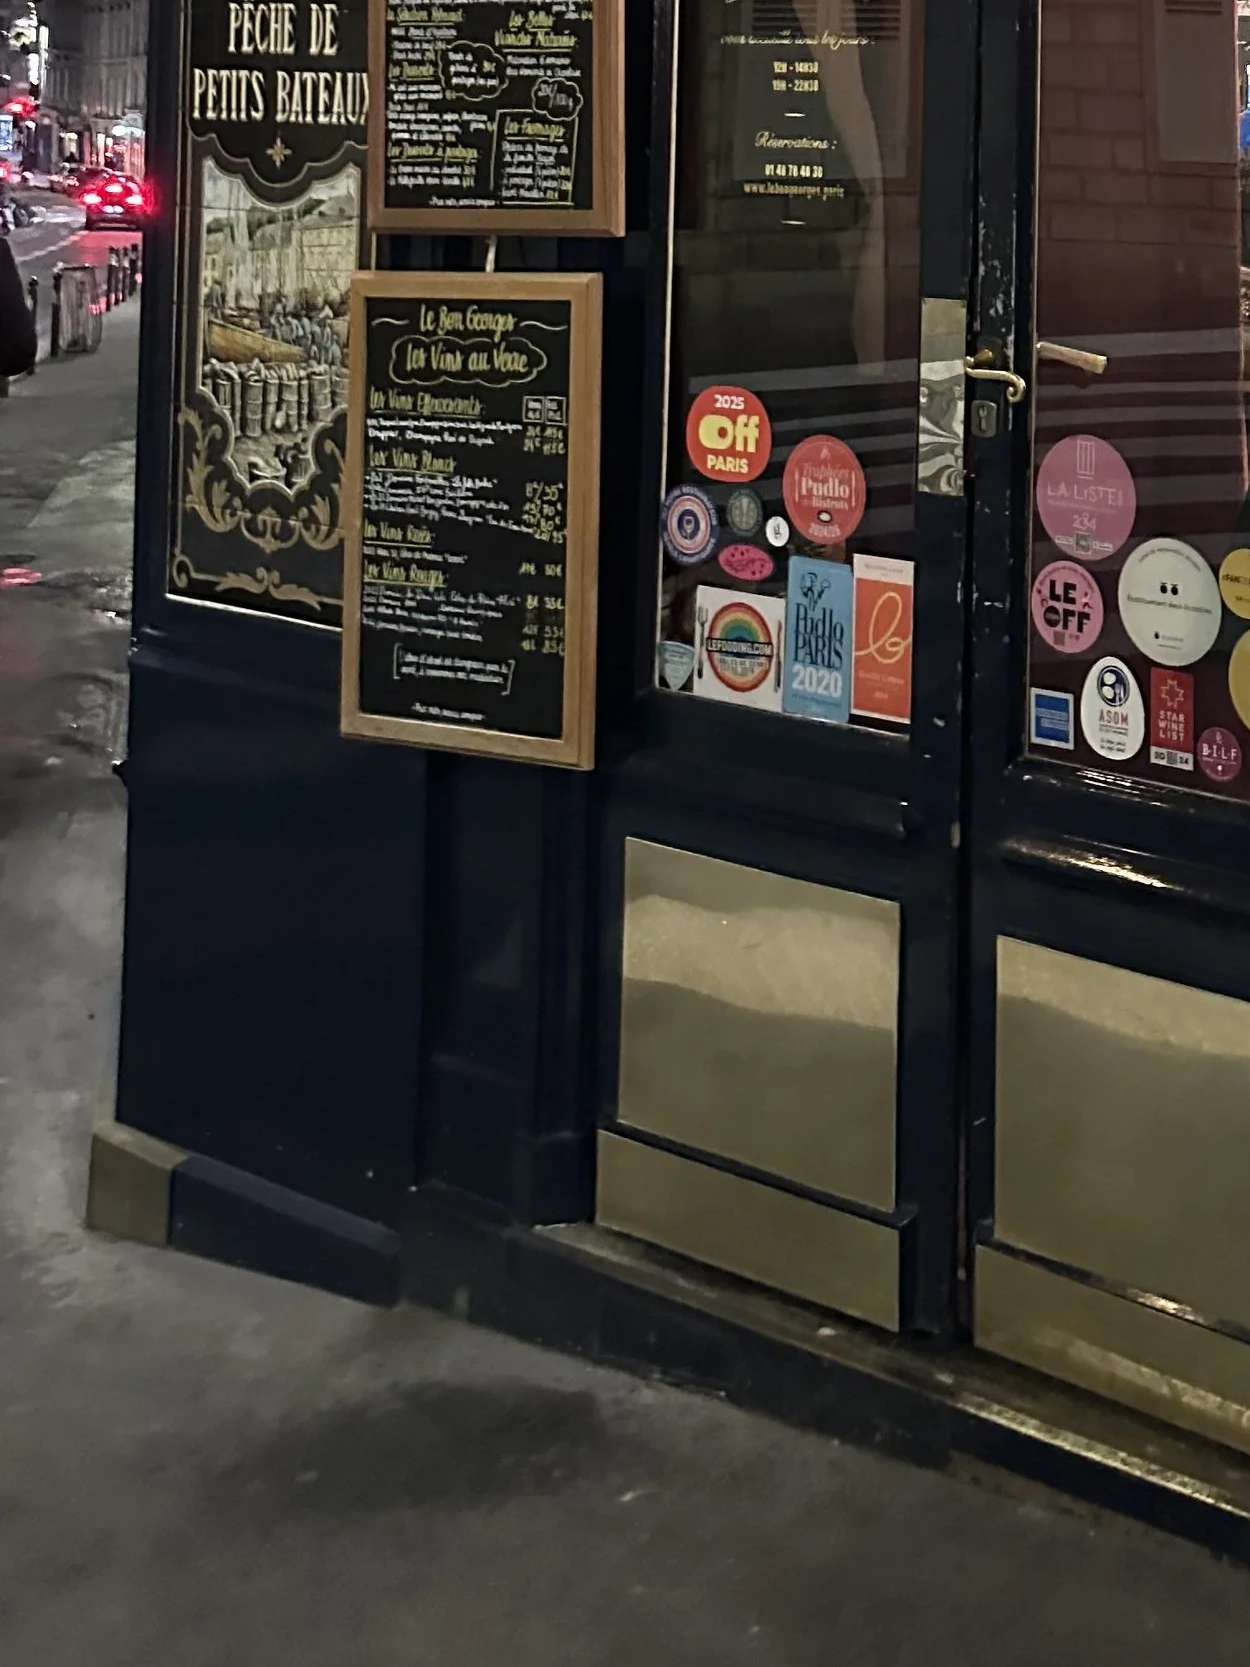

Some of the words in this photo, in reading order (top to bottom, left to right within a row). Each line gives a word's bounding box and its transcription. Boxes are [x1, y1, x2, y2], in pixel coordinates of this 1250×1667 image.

[309, 3, 340, 56] DE
[192, 67, 265, 122] PETITS
[420, 304, 436, 332] Le
[438, 306, 464, 335] Bon
[466, 304, 517, 343] Georges
[431, 342, 464, 372] Vins
[468, 351, 491, 371] au
[714, 393, 745, 410] 2025
[698, 413, 761, 453] Off
[706, 453, 750, 475] PARIS
[801, 476, 850, 498] Pudlo
[1047, 482, 1068, 498] LA
[1049, 578, 1077, 605] LE
[795, 602, 844, 640] Pudlo
[1043, 605, 1091, 634] OFF
[793, 634, 843, 672] PARIS
[791, 665, 843, 698] 2020
[1099, 709, 1129, 726] ASOM
[1158, 719, 1185, 731] WINE
[1159, 710, 1185, 722] STAR
[1159, 729, 1185, 742] LIST
